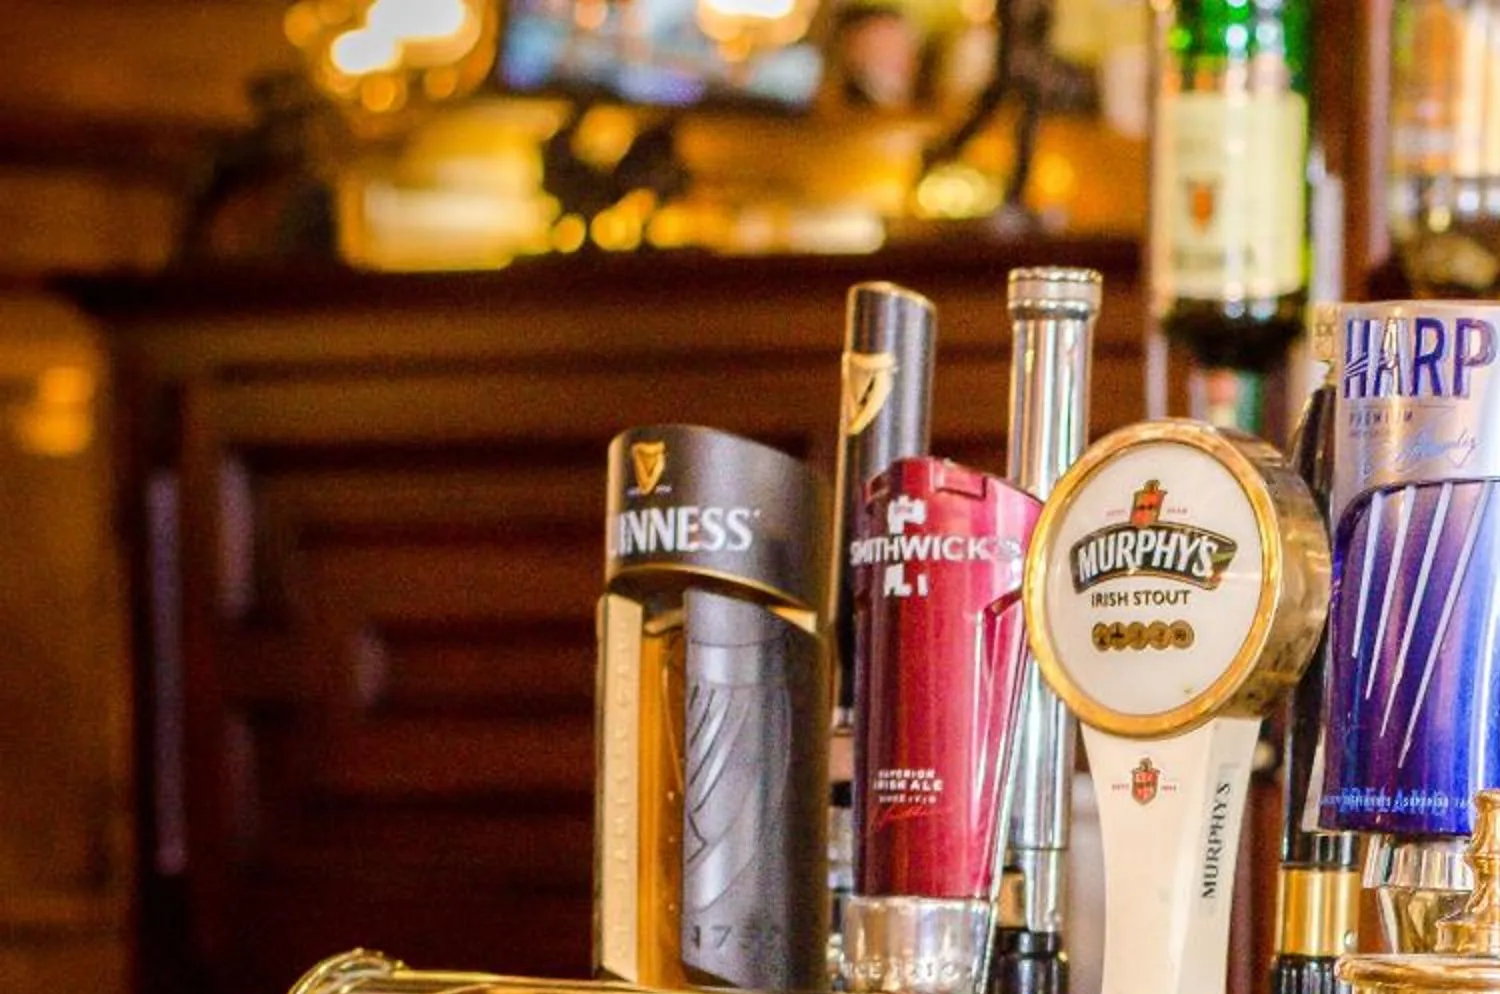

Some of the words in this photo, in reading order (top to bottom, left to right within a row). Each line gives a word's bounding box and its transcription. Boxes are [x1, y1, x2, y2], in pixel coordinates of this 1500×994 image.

[1343, 317, 1500, 399] HARP
[618, 506, 753, 557] INNESS
[1091, 592, 1129, 608] IRISH
[1133, 589, 1192, 607] STOUT
